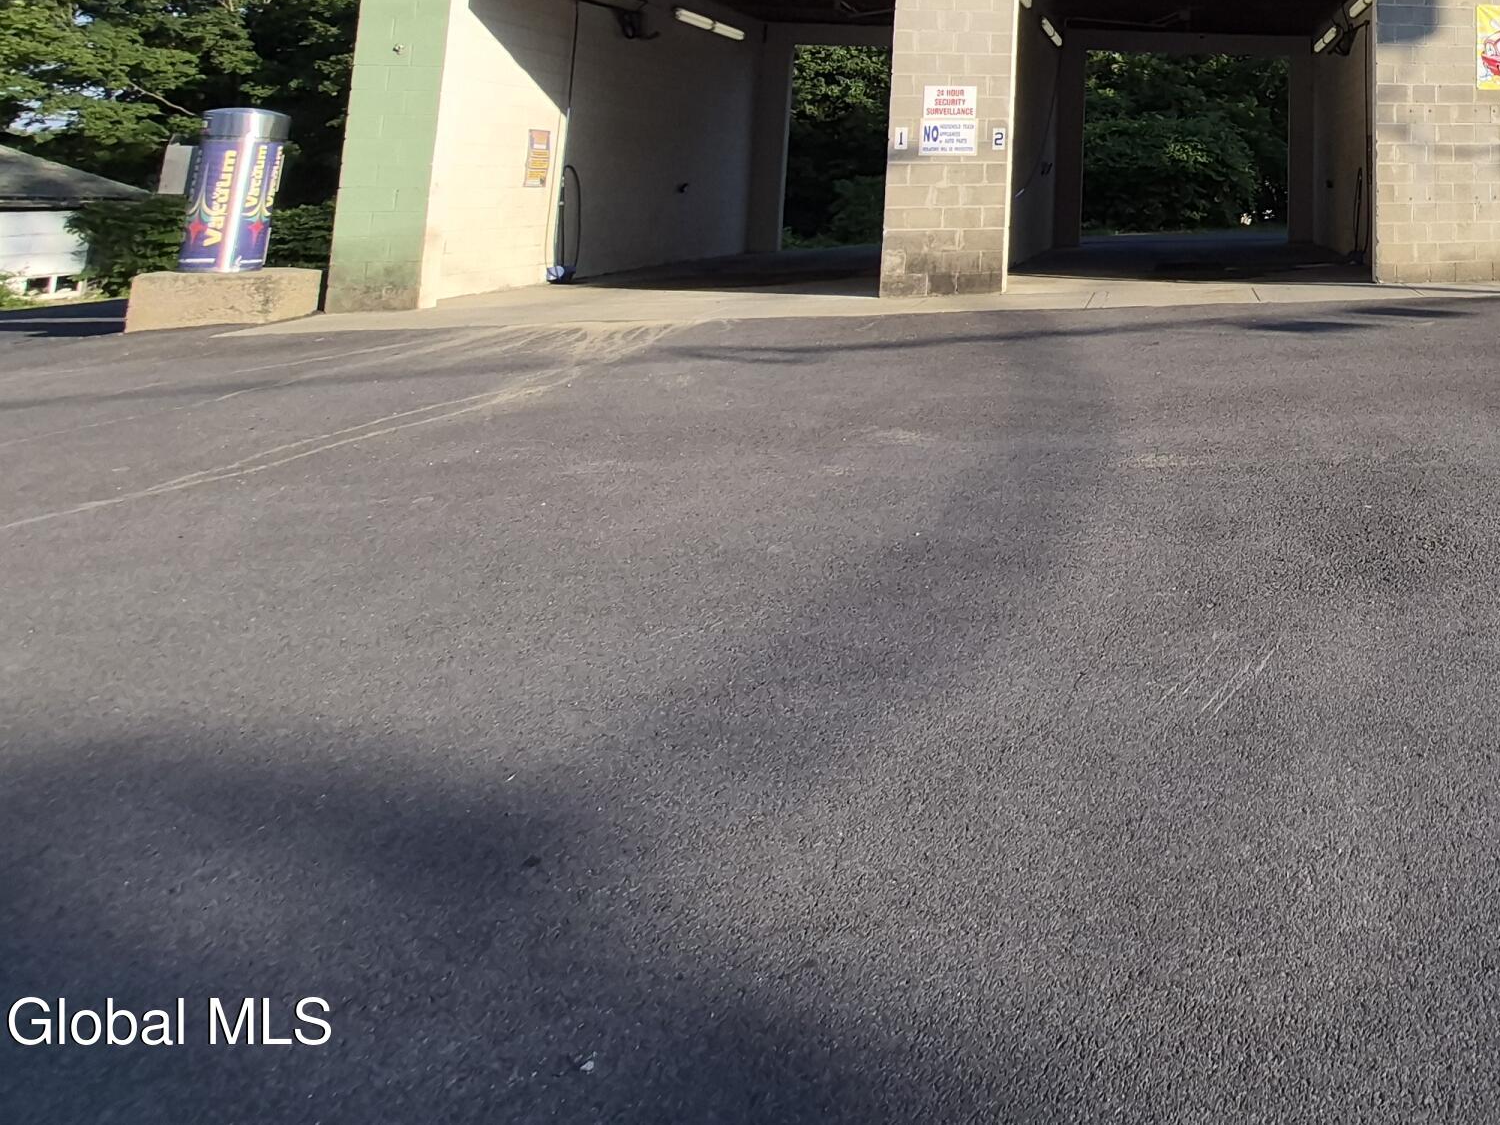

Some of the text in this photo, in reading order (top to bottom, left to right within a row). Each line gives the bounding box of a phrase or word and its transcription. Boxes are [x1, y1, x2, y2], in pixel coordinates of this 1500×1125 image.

[946, 89, 965, 97] HOUR
[934, 98, 966, 106] SECURITY
[926, 107, 974, 116] SURVEILLANCE
[898, 131, 904, 145] 1
[923, 125, 939, 142] NO
[993, 132, 1004, 146] 2
[245, 145, 268, 207] Vacuum
[203, 150, 238, 247] Vacuum
